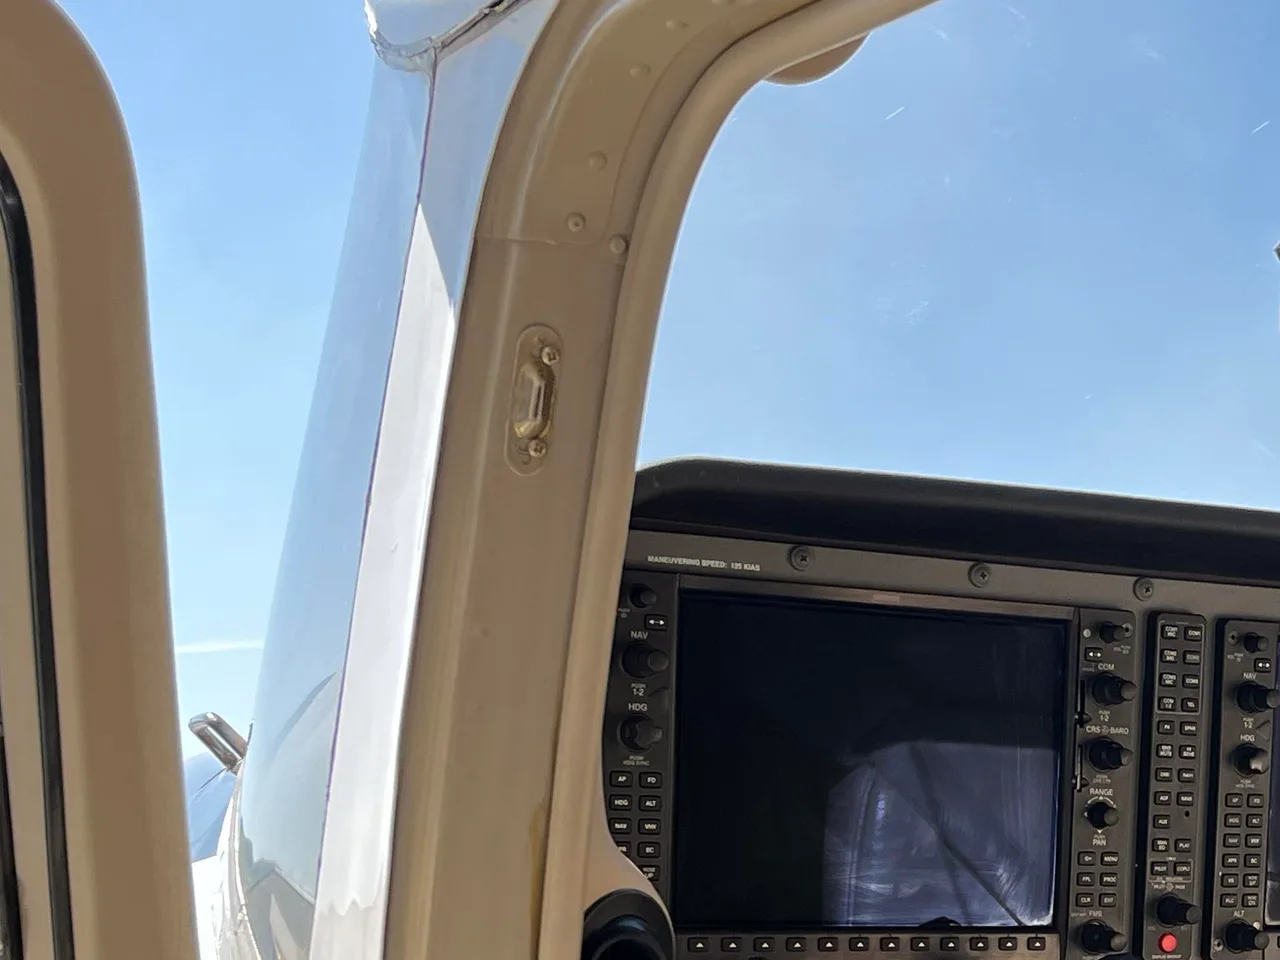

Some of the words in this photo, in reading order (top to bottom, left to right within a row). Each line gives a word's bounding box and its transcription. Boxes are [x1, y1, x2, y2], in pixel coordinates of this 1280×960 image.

[631, 631, 648, 639] NAV
[1243, 672, 1257, 680] NAV
[628, 703, 648, 711] HDG
[1089, 788, 1114, 796] RANGE
[1092, 838, 1107, 846] PAN
